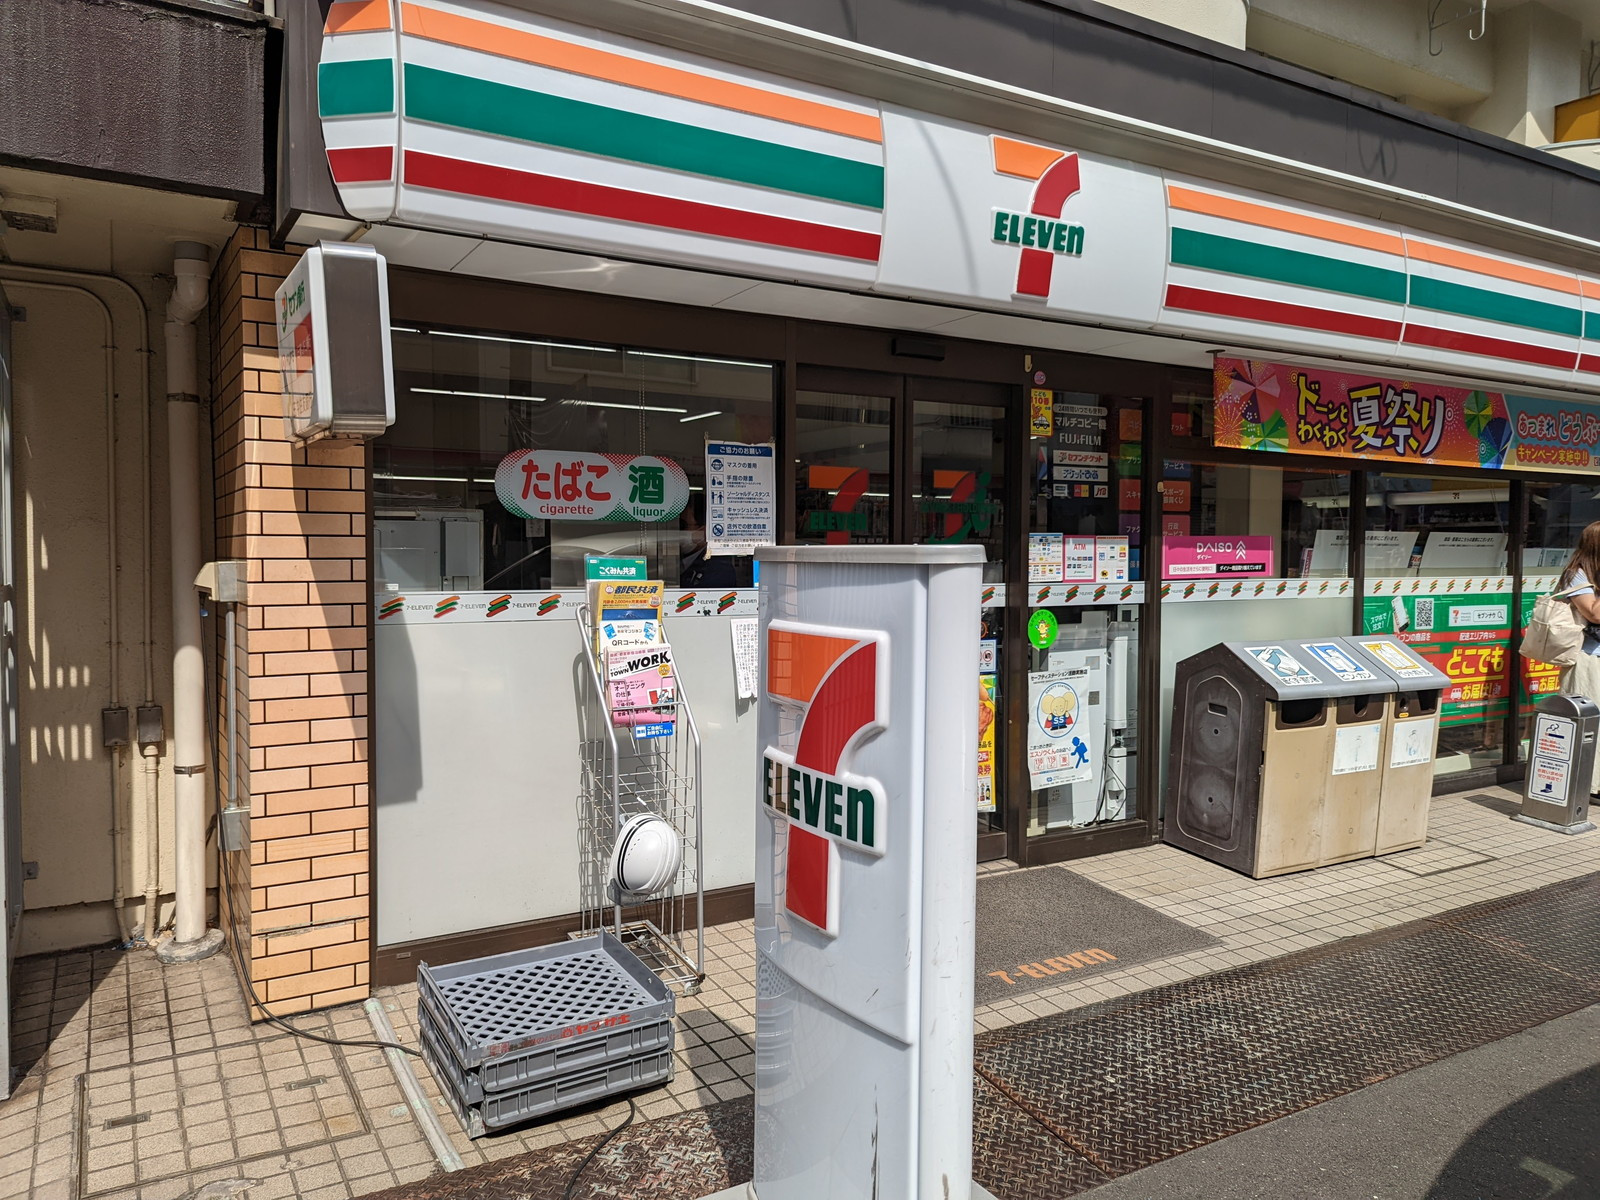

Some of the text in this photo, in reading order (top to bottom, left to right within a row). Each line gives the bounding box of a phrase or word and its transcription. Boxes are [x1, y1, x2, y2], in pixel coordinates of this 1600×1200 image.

[1298, 375, 1348, 423] ドーンと
[1055, 416, 1106, 430] マルチコピー機
[1350, 386, 1445, 455] 夏祭り
[1298, 420, 1346, 448] わくわく
[1559, 412, 1600, 443] どうぶ
[1059, 433, 1101, 446] FUJIFILM
[720, 446, 762, 455] ご協力のお願い
[1068, 453, 1103, 462] セブンチケット
[521, 459, 612, 502] たばこ
[1063, 469, 1099, 479] チケットぴあ
[629, 464, 665, 506] 酒
[1163, 489, 1185, 497] スポーツ
[539, 504, 594, 517] cigarette
[633, 506, 666, 519] liquor
[1073, 543, 1087, 551] ATM
[1196, 543, 1233, 553] DAISO
[599, 566, 636, 576] こくみん共済
[615, 586, 659, 594] 都民共済
[610, 667, 630, 677] TOWN
[627, 651, 671, 672] WORK
[1446, 647, 1504, 676] どこでも
[1053, 716, 1065, 725] SS
